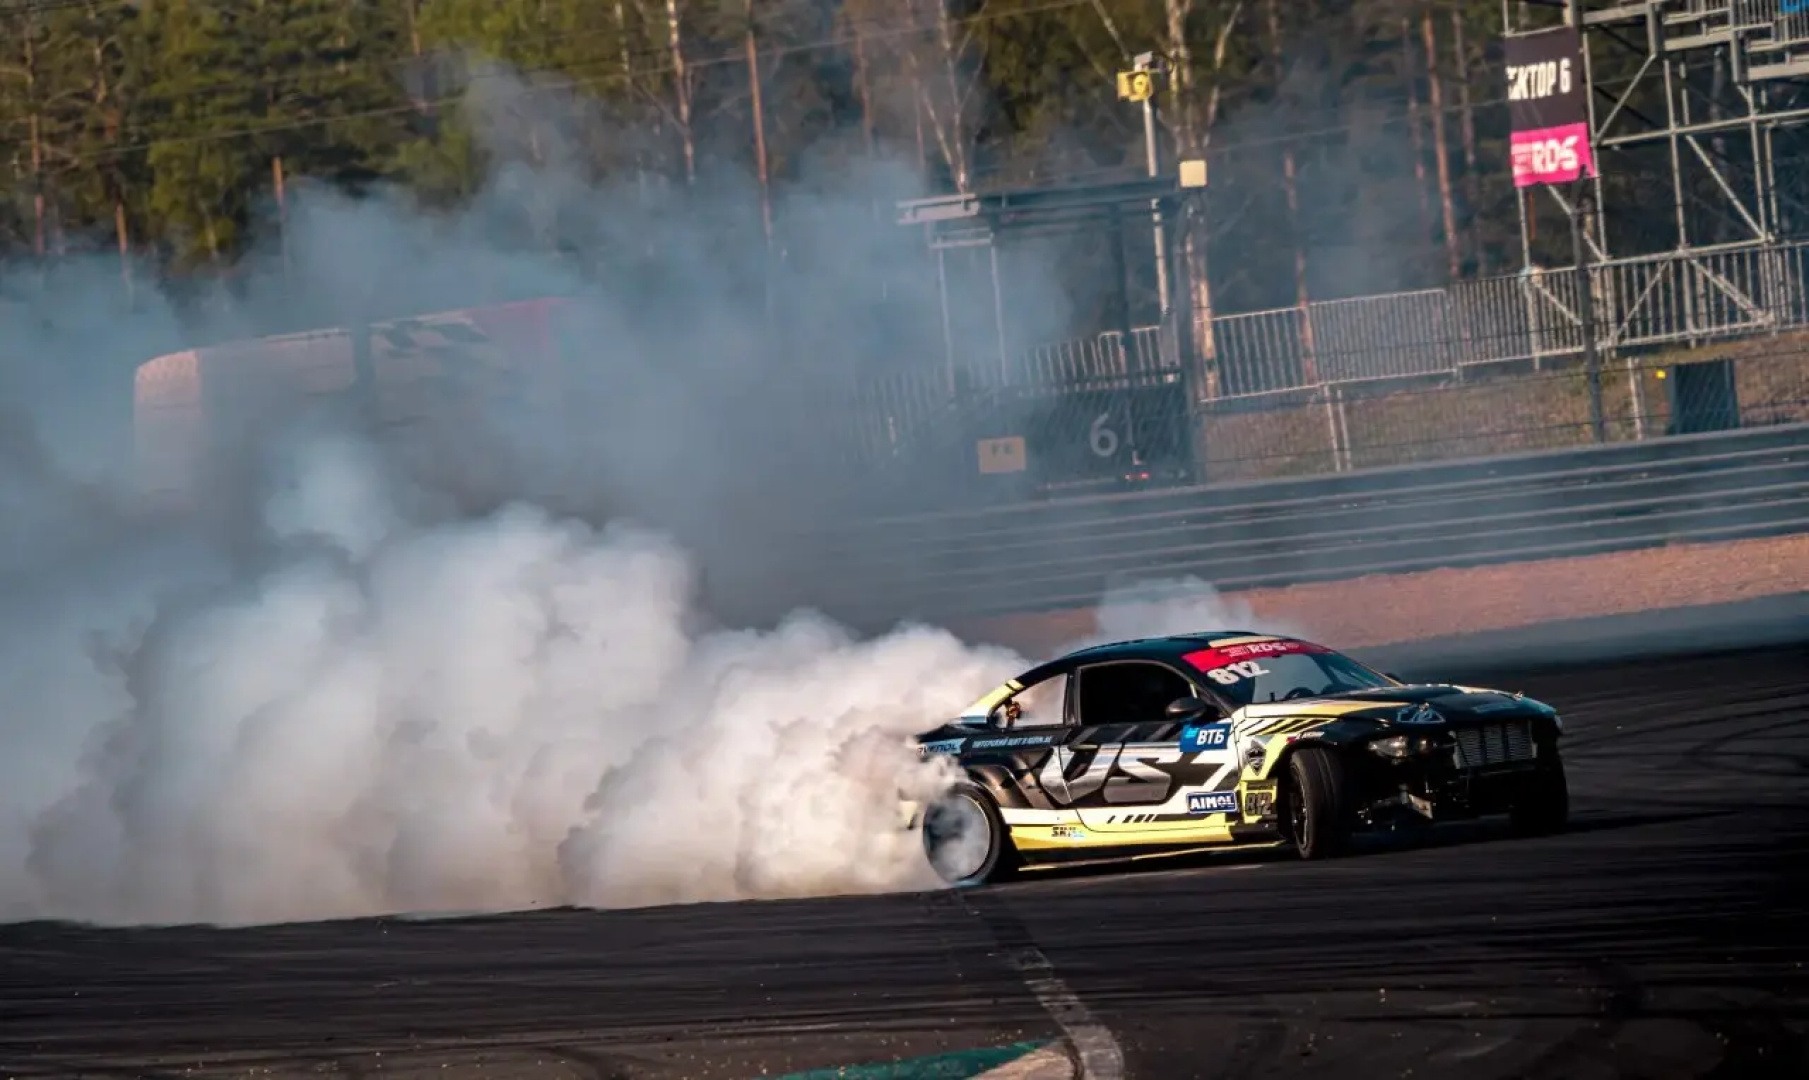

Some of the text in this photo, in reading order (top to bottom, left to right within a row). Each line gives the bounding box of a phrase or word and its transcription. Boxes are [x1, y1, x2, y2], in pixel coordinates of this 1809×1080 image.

[1559, 57, 1571, 94] 6
[1531, 135, 1579, 175] RDS
[1090, 412, 1118, 457] 6
[1207, 660, 1271, 685] 812
[1197, 728, 1226, 746] ВТБ
[1189, 795, 1234, 810] AIMOL
